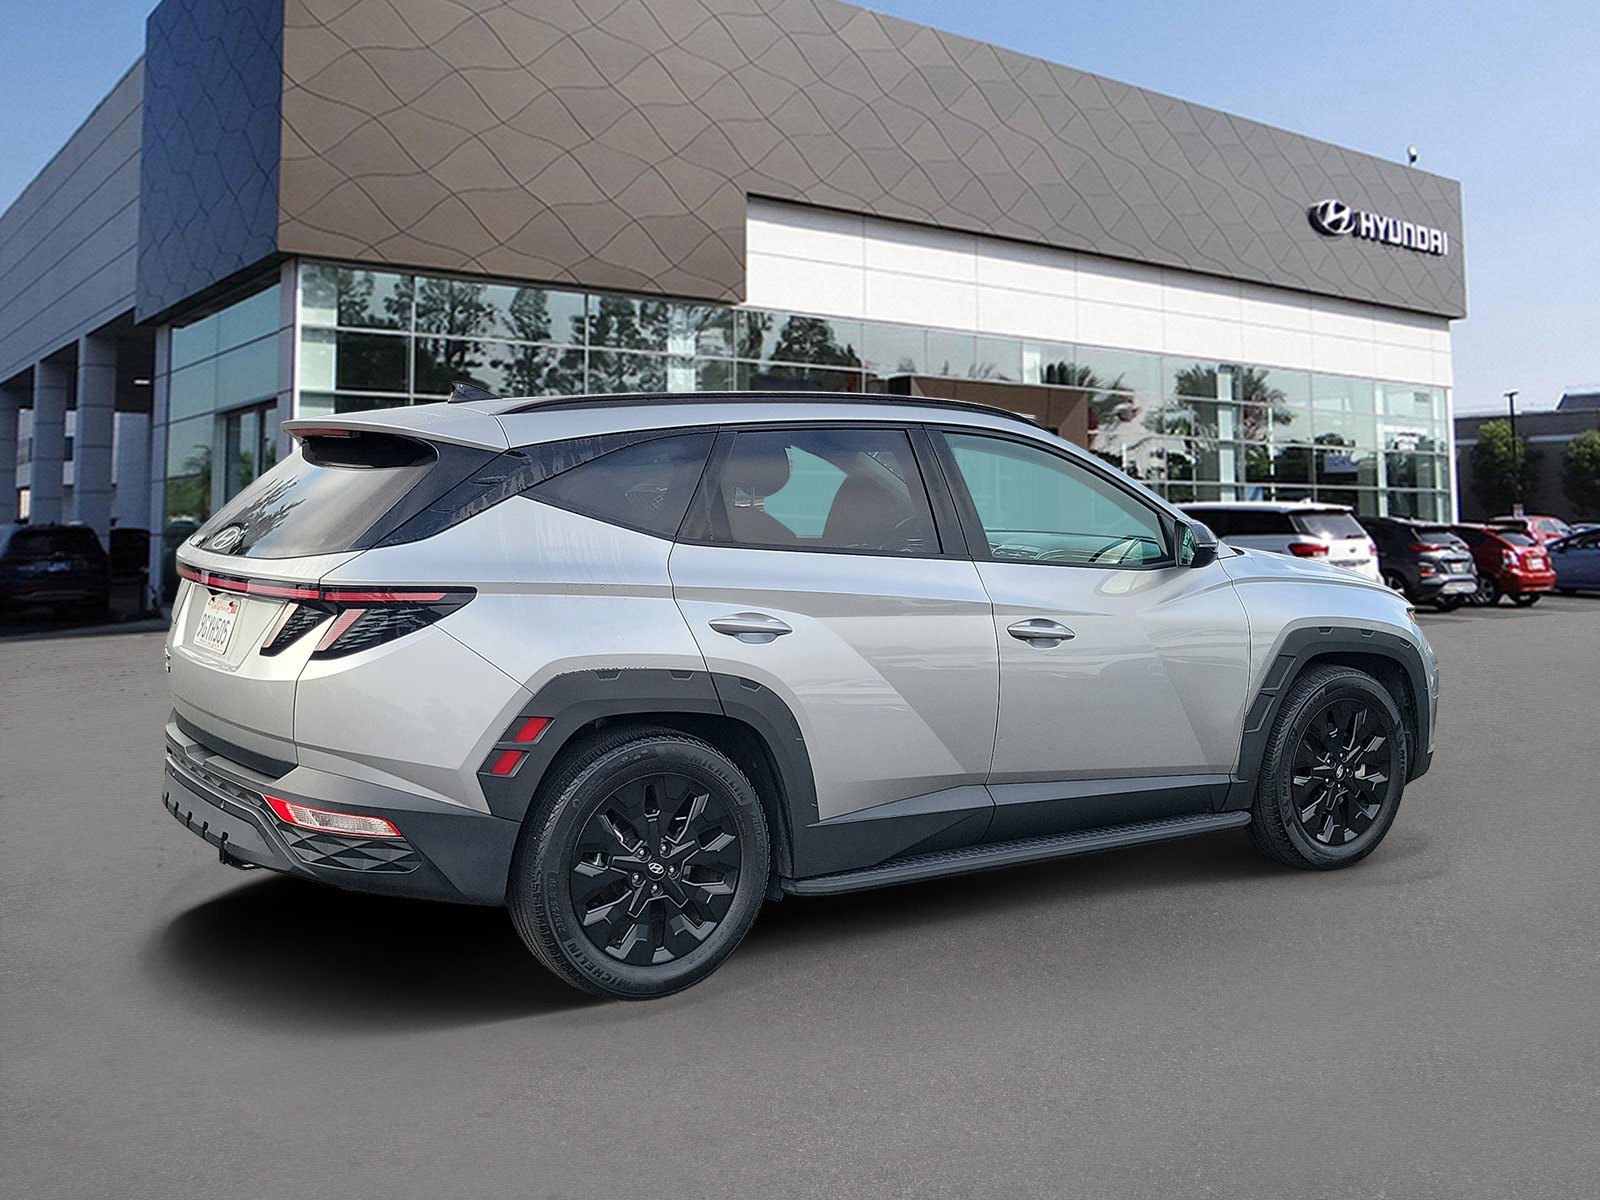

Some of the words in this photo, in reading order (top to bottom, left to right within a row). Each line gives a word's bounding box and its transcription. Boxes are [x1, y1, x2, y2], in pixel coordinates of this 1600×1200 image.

[1358, 210, 1448, 256] HYUNDAI
[690, 755, 746, 802] MICHELIN
[566, 943, 632, 988] MICHELIN
